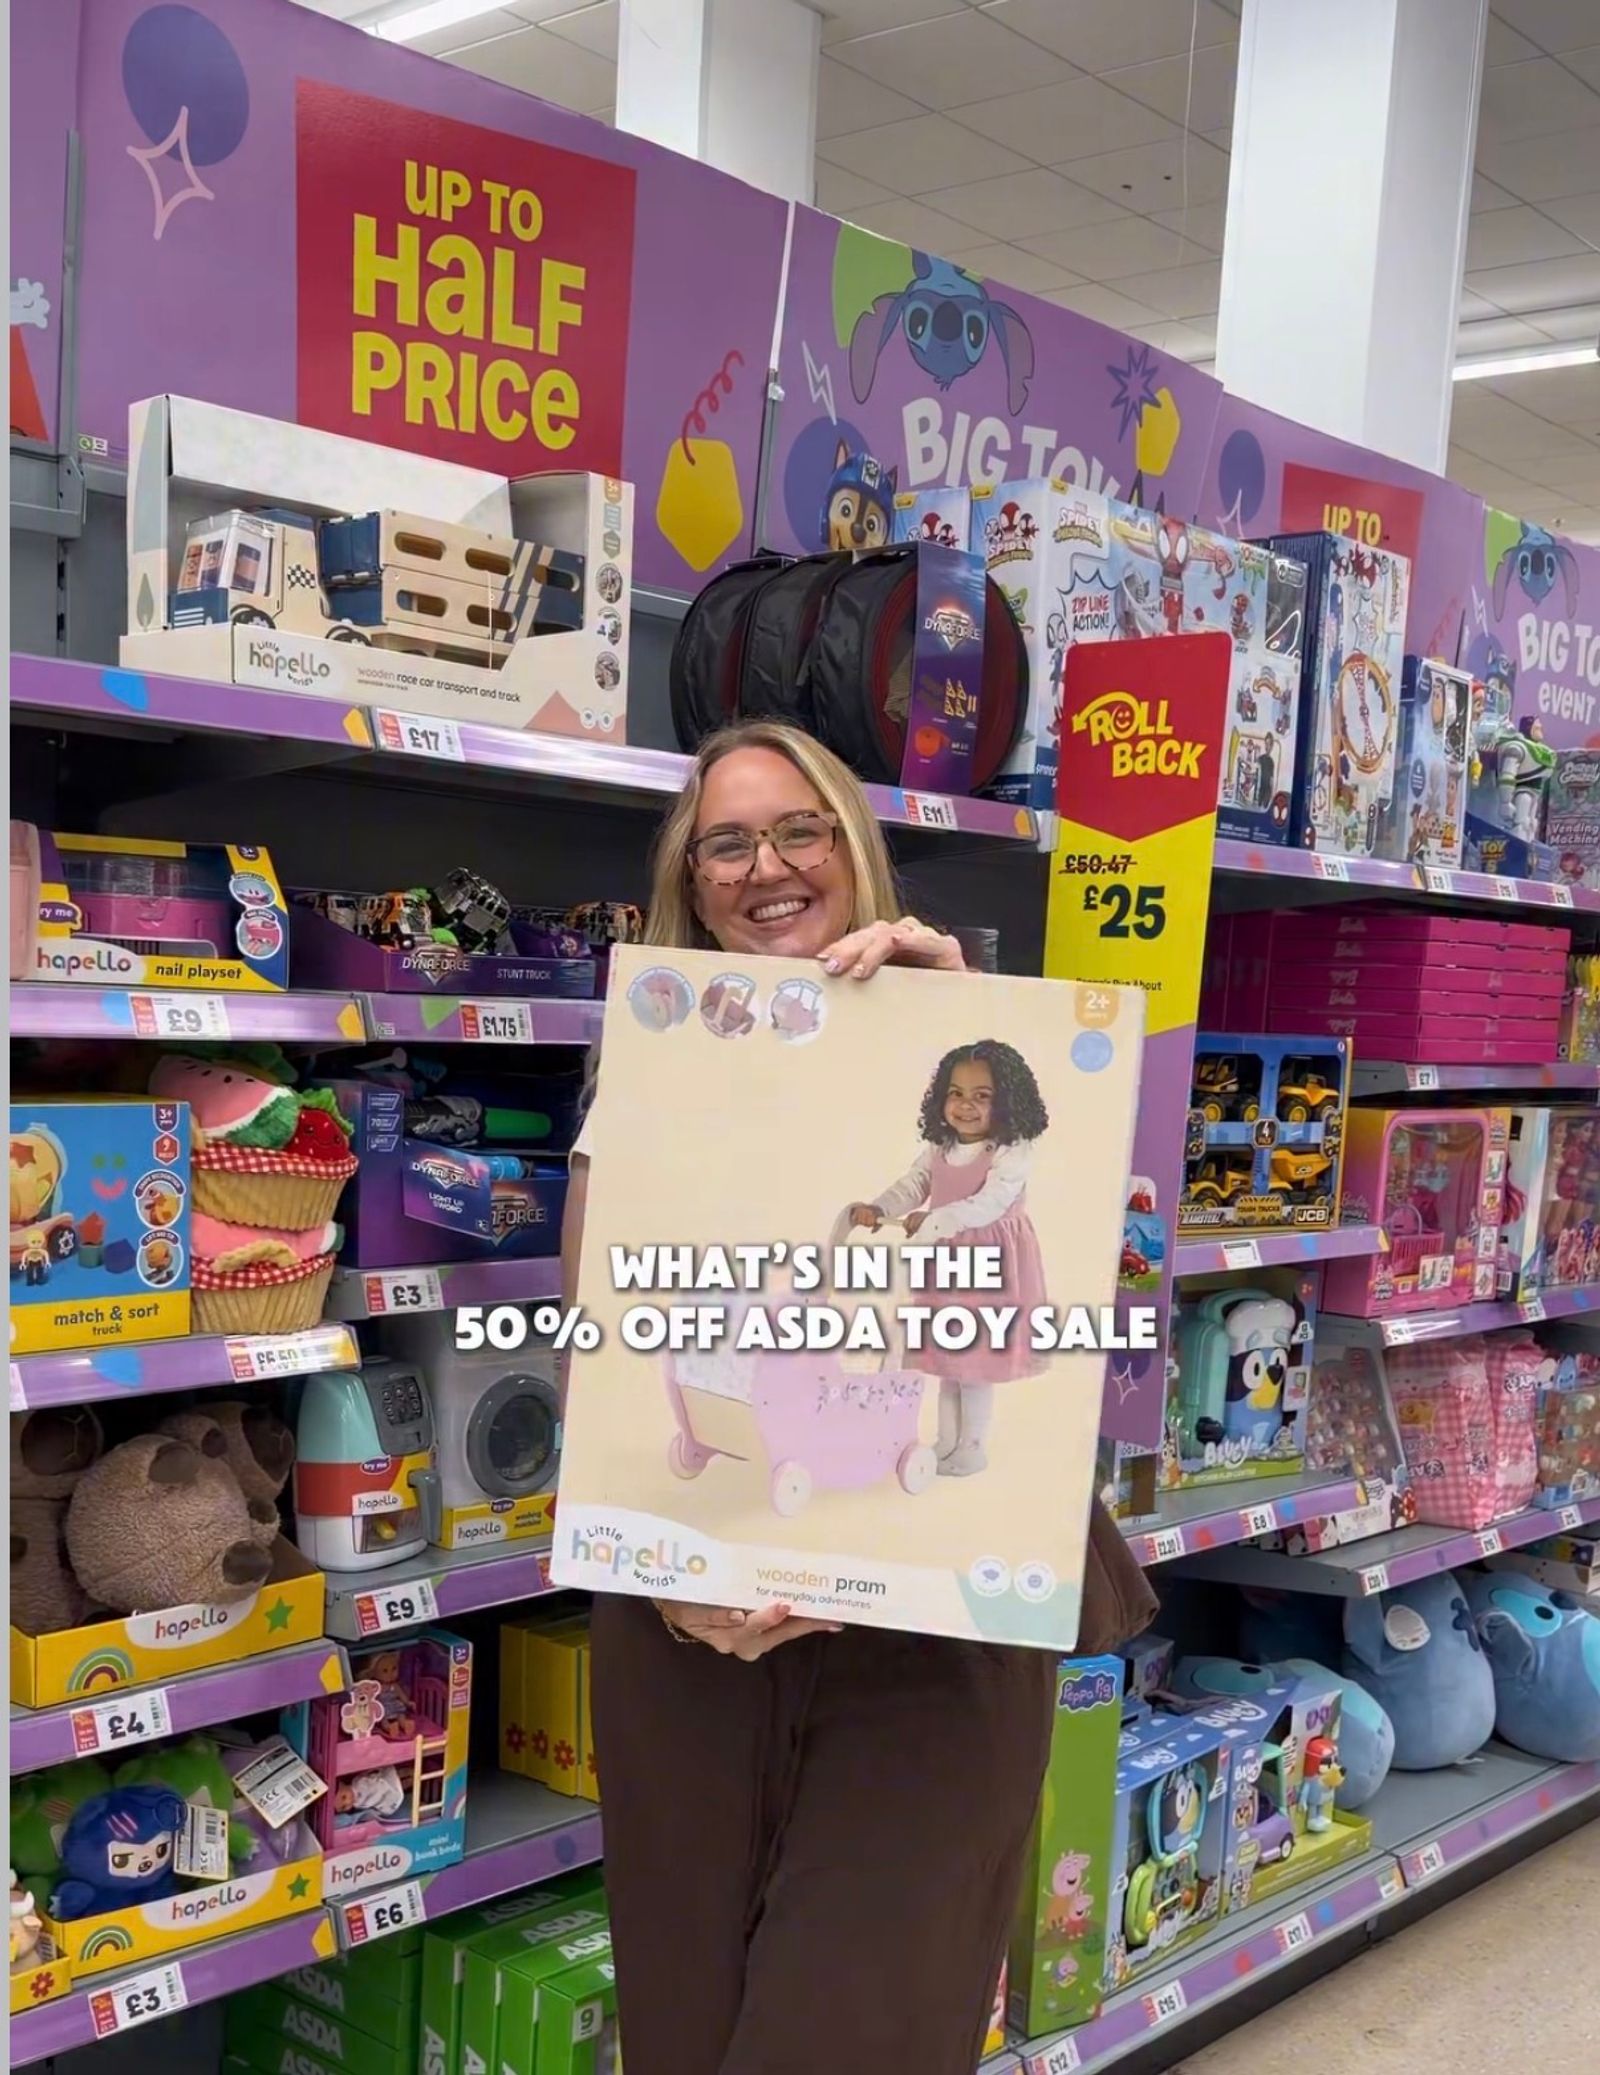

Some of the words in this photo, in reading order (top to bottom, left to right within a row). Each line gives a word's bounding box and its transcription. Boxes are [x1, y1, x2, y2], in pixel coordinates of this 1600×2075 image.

[481, 179, 544, 242] TO
[902, 397, 1012, 488] BIG
[1323, 504, 1353, 533] UP
[1356, 510, 1383, 546] TO
[1089, 595, 1110, 612] LINE
[1518, 612, 1571, 673] BIG
[249, 642, 330, 679] hapello
[356, 666, 396, 681] wooden
[396, 673, 419, 686] race
[419, 677, 436, 689] car
[436, 680, 480, 698] transport
[480, 685, 498, 700] and
[498, 687, 521, 703] track
[1089, 698, 1174, 746] ROLL
[409, 725, 440, 752] £17
[923, 805, 945, 824] £11
[1551, 822, 1600, 834] Vending
[1062, 855, 1133, 874] £50.47
[40, 906, 51, 919] ry
[55, 908, 73, 918] me
[1083, 884, 1166, 940] £25
[37, 947, 132, 976] hapello
[156, 963, 183, 978] nail
[187, 964, 243, 980] playset
[402, 956, 471, 972] DYNAFORCE
[497, 968, 524, 980] STUNT
[526, 968, 551, 981] TRUCK
[1086, 990, 1110, 1010] 2+
[167, 1008, 202, 1033] £9
[483, 1016, 517, 1037] £1.75
[160, 1108, 173, 1120] 3+
[1297, 1209, 1327, 1223] JCB
[392, 1285, 422, 1307] £3
[54, 1304, 104, 1327] match
[110, 1306, 123, 1322] &
[128, 1303, 161, 1320] sort
[92, 1322, 123, 1337] truck
[358, 1495, 399, 1510] hapello
[457, 1521, 501, 1541] hapello
[586, 1523, 623, 1541] Little
[571, 1528, 708, 1576] hapello
[632, 1568, 677, 1587] worlds
[756, 1565, 830, 1588] wooden
[835, 1573, 887, 1597] pram
[386, 1597, 416, 1623] £9
[756, 1585, 770, 1597] for
[772, 1588, 816, 1606] everyday
[818, 1593, 872, 1610] adventures
[155, 1607, 228, 1640] hapello
[1064, 1681, 1095, 1706] Peppa
[1095, 1677, 1113, 1700] Pig
[108, 1711, 145, 1740] £4
[428, 1833, 449, 1847] mini
[415, 1846, 438, 1861] bunk
[331, 1852, 401, 1884] hapello
[171, 1885, 247, 1921] hapello
[375, 1902, 404, 1931] £6
[520, 1909, 604, 1944] ASDA
[557, 1931, 611, 1961] ASD
[125, 1986, 161, 2020] £3
[285, 1968, 345, 2012] ASDA
[281, 2004, 344, 2061] ASDA
